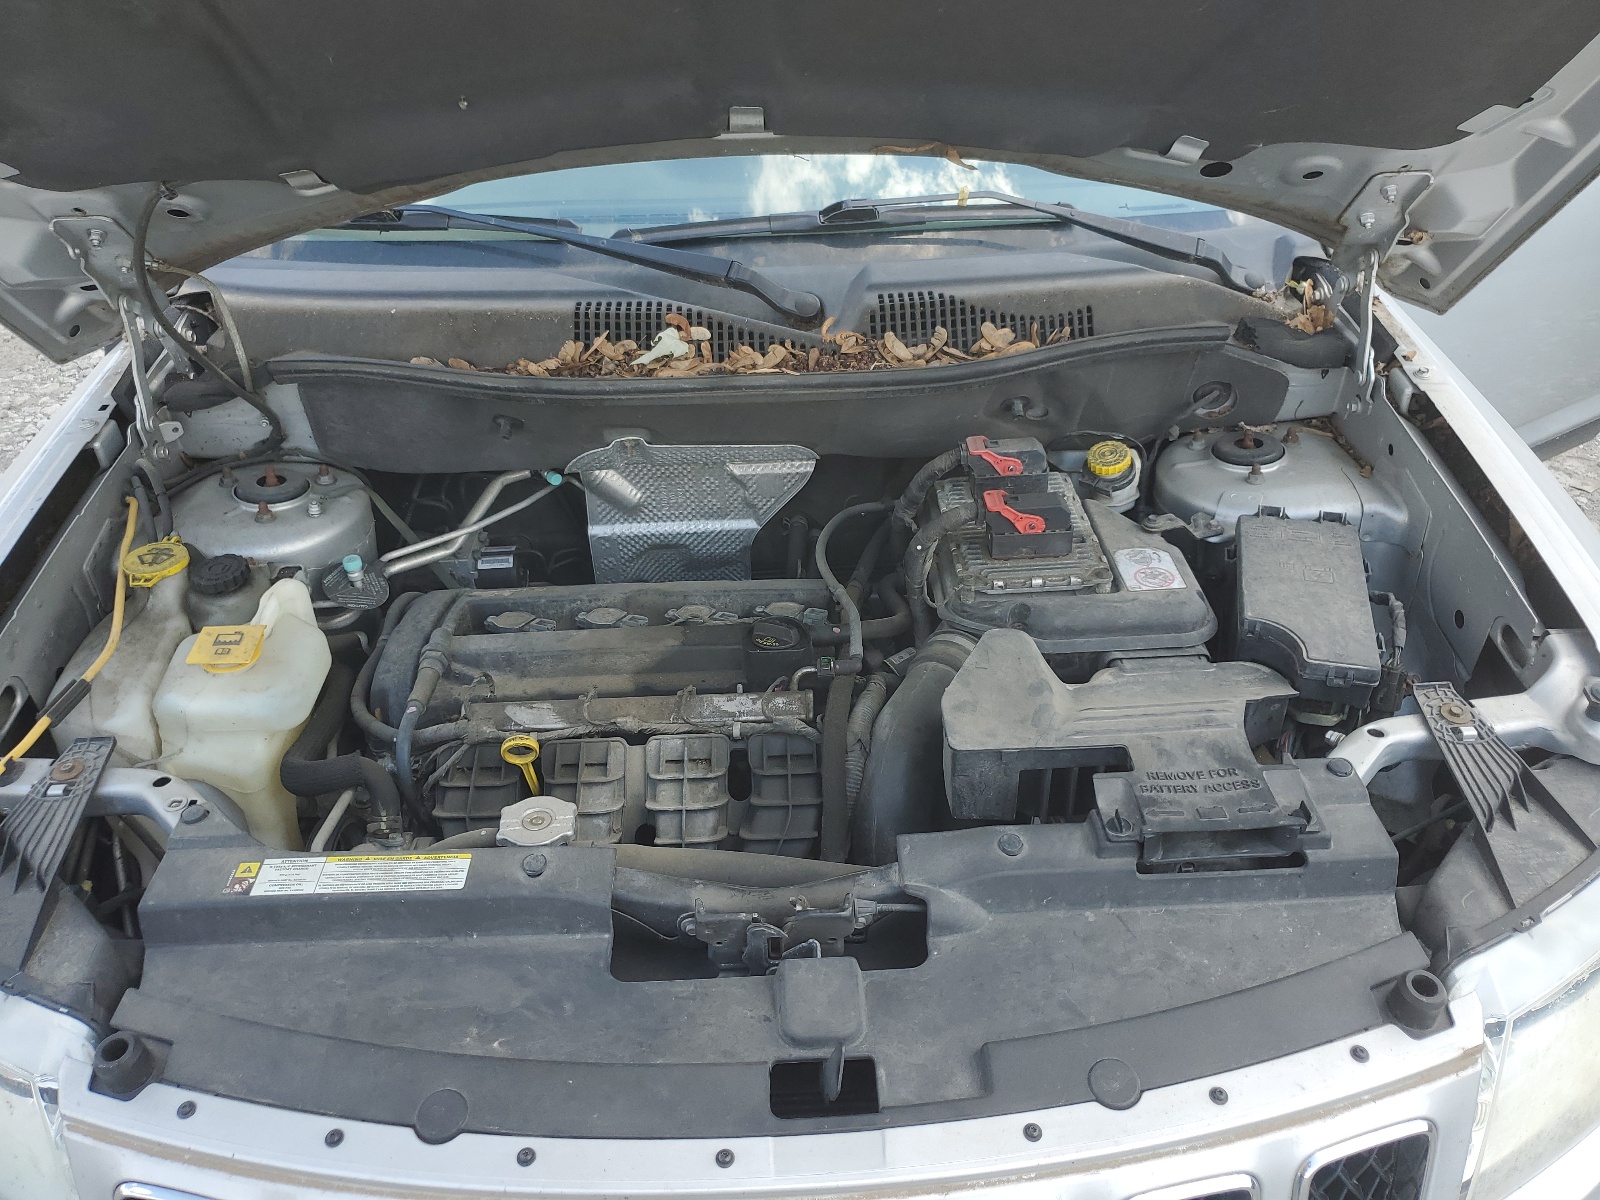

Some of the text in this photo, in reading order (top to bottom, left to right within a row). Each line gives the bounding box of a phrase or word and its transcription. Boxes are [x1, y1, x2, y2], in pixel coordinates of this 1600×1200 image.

[1145, 767, 1240, 781] REMOVE FOR
[1139, 779, 1261, 794] BATTERY ACCESS
